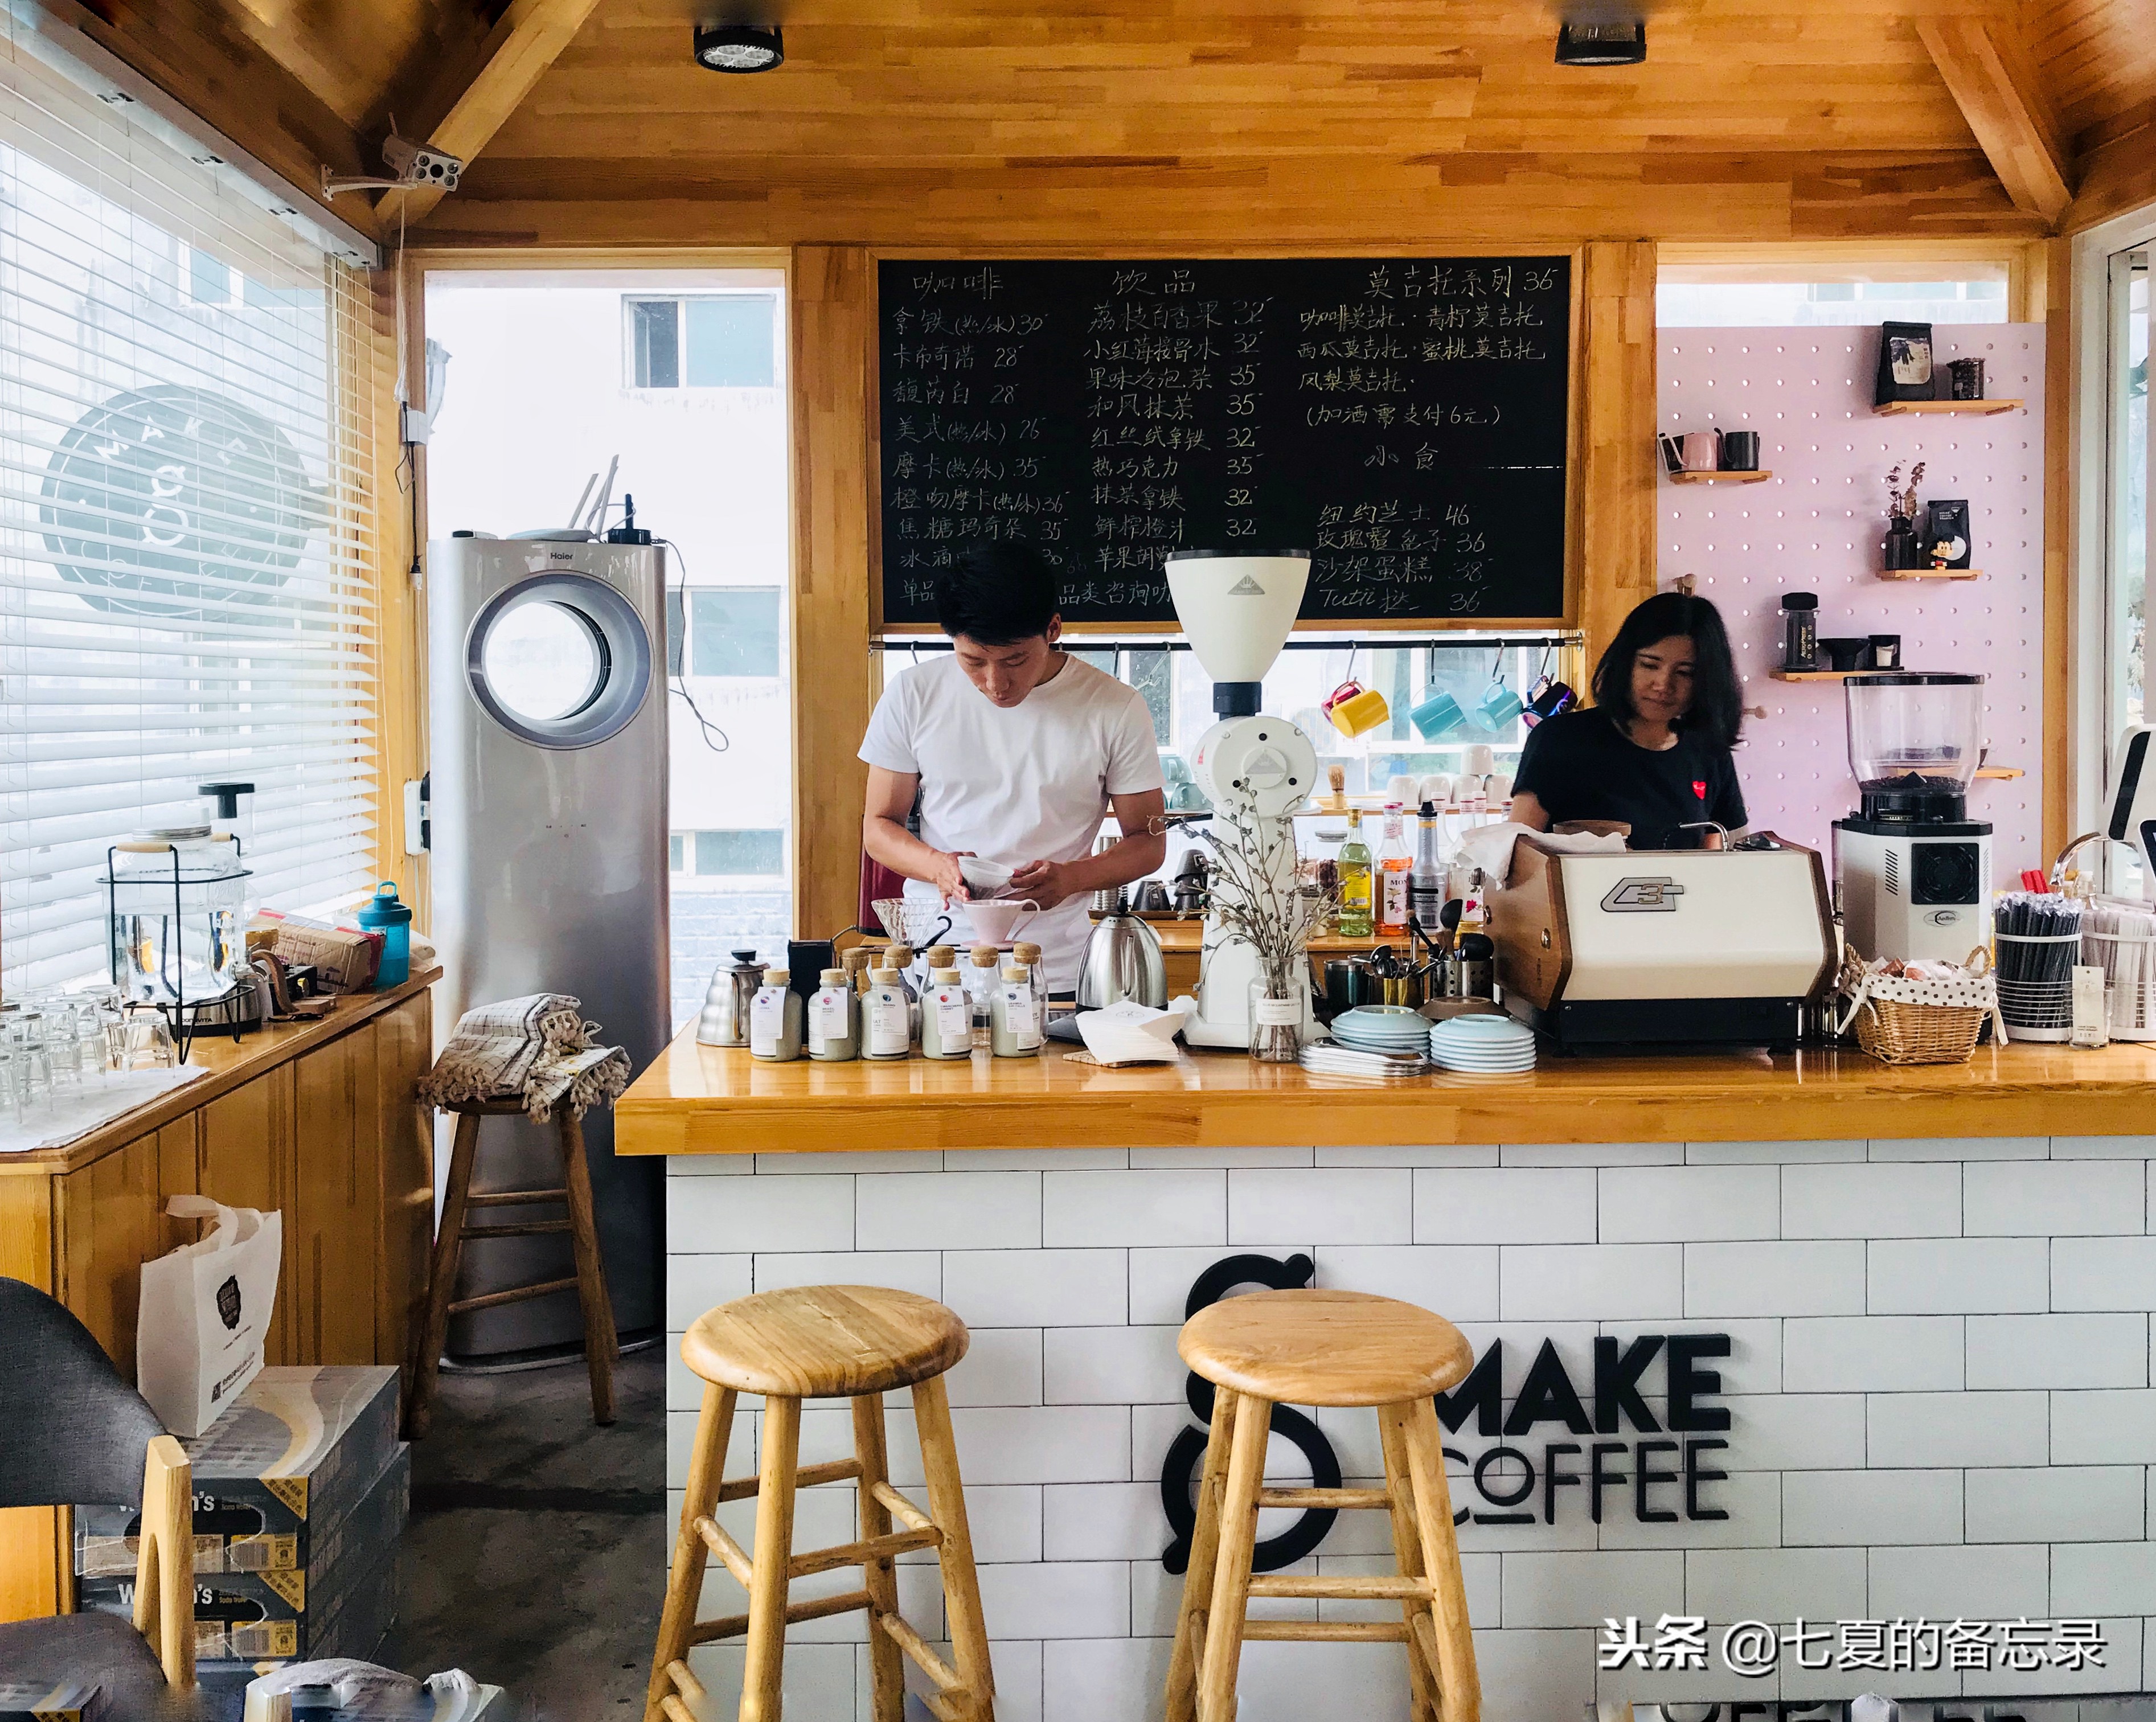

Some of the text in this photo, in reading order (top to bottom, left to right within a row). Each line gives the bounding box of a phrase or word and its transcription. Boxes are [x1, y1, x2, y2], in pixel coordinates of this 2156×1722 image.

[913, 266, 1003, 301] 咖啡
[1112, 269, 1195, 295] 饮品
[1364, 265, 1511, 298] 莫吉托系列
[1088, 300, 1223, 335] 荔枝百香果
[893, 342, 973, 370] 卡布奇诺
[893, 375, 968, 404] 馥芮白
[1087, 363, 1212, 390] 果味冷泡茶
[1088, 392, 1193, 420] 和风抹茶
[1091, 425, 1211, 451] 红丝绒拿铁
[1092, 456, 1178, 479] 热巧克力
[1364, 442, 1438, 470] 小食
[1091, 483, 1186, 511] 抹茶拿铁
[897, 515, 1026, 540] 焦糖玛奇朵
[1317, 499, 1430, 528] 纽约芝士
[1095, 514, 1182, 543] 鲜榨橙汁
[1315, 524, 1446, 551] 玫瑰覆盆子
